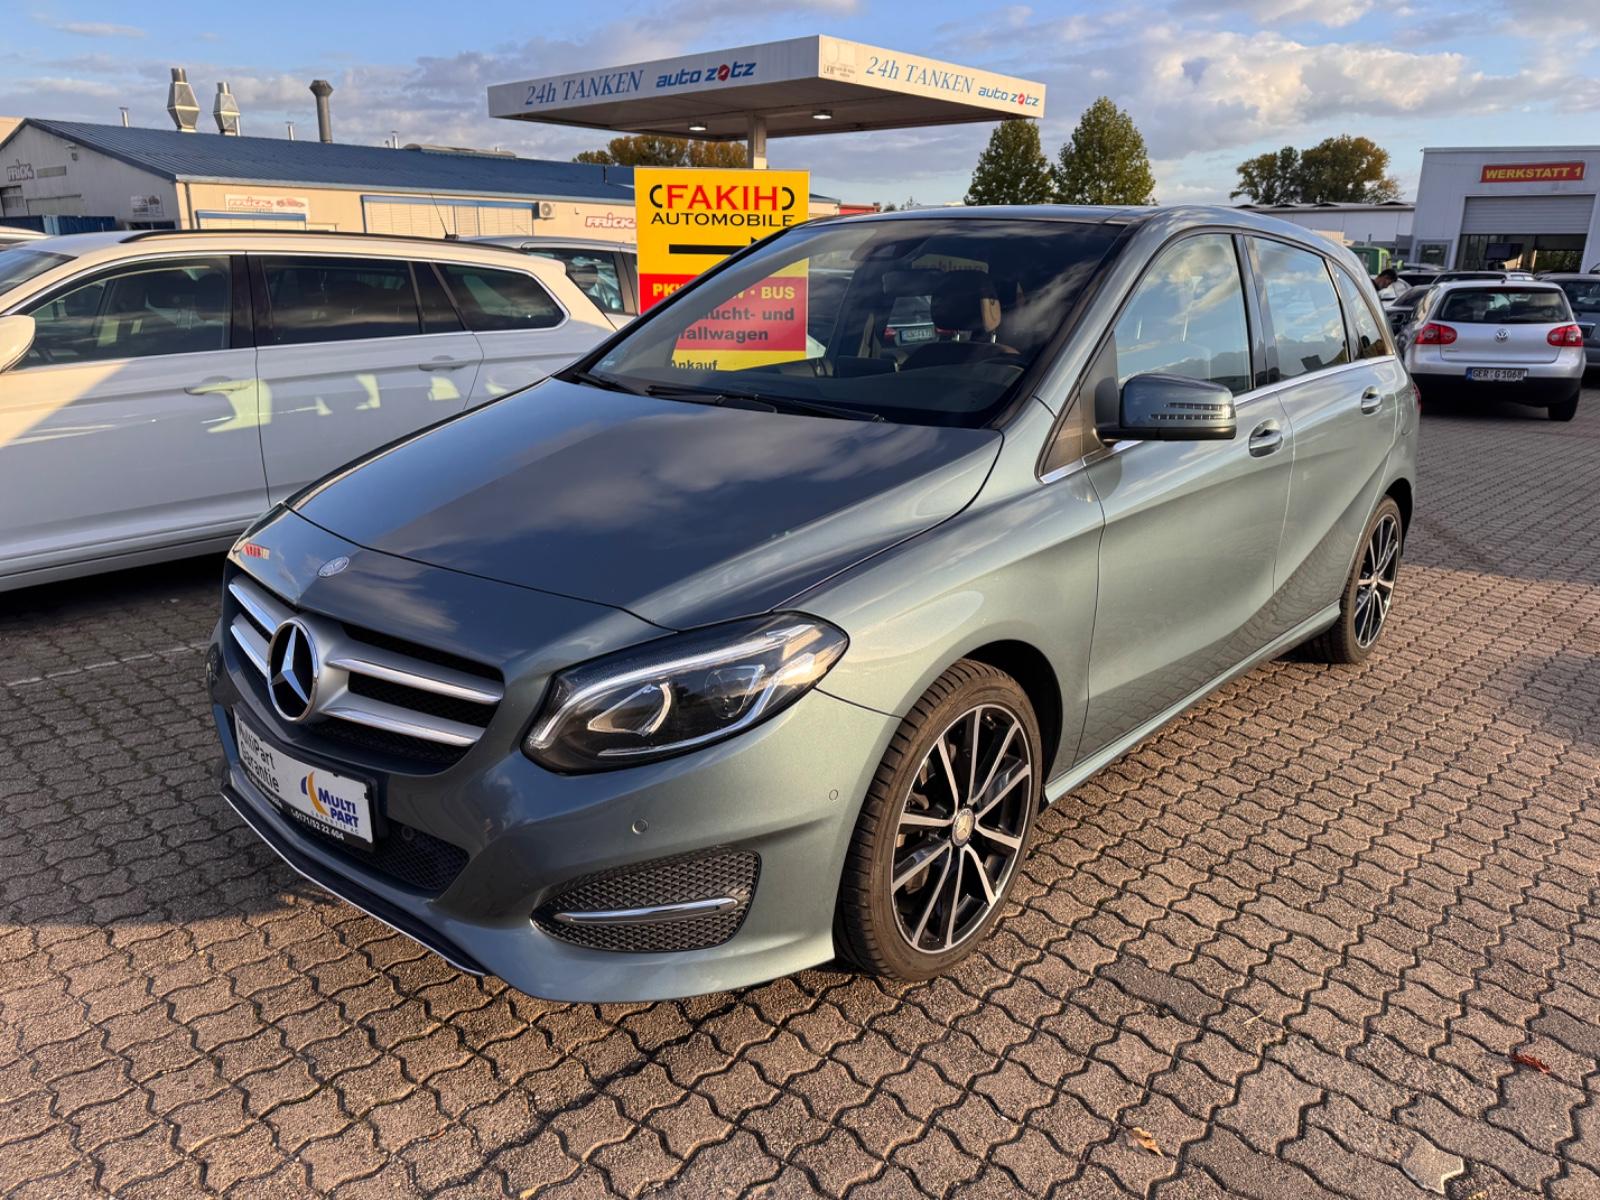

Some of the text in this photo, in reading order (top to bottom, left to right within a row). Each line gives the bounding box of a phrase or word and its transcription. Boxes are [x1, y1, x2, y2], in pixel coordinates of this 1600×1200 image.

[525, 61, 757, 105] 24h TANKEN auto zotz
[865, 56, 900, 80] 24h
[904, 64, 975, 94] TANKEN
[978, 86, 1008, 101] auto
[1009, 92, 1040, 107] zotz
[1486, 166, 1582, 179] WERKSTATT 1
[666, 184, 778, 211] FAKIH
[650, 212, 796, 228] AUTOMOBILE
[761, 286, 795, 300] BUS
[706, 307, 795, 321] ucht- und
[318, 787, 356, 815] MULTI
[330, 807, 359, 828] PART
